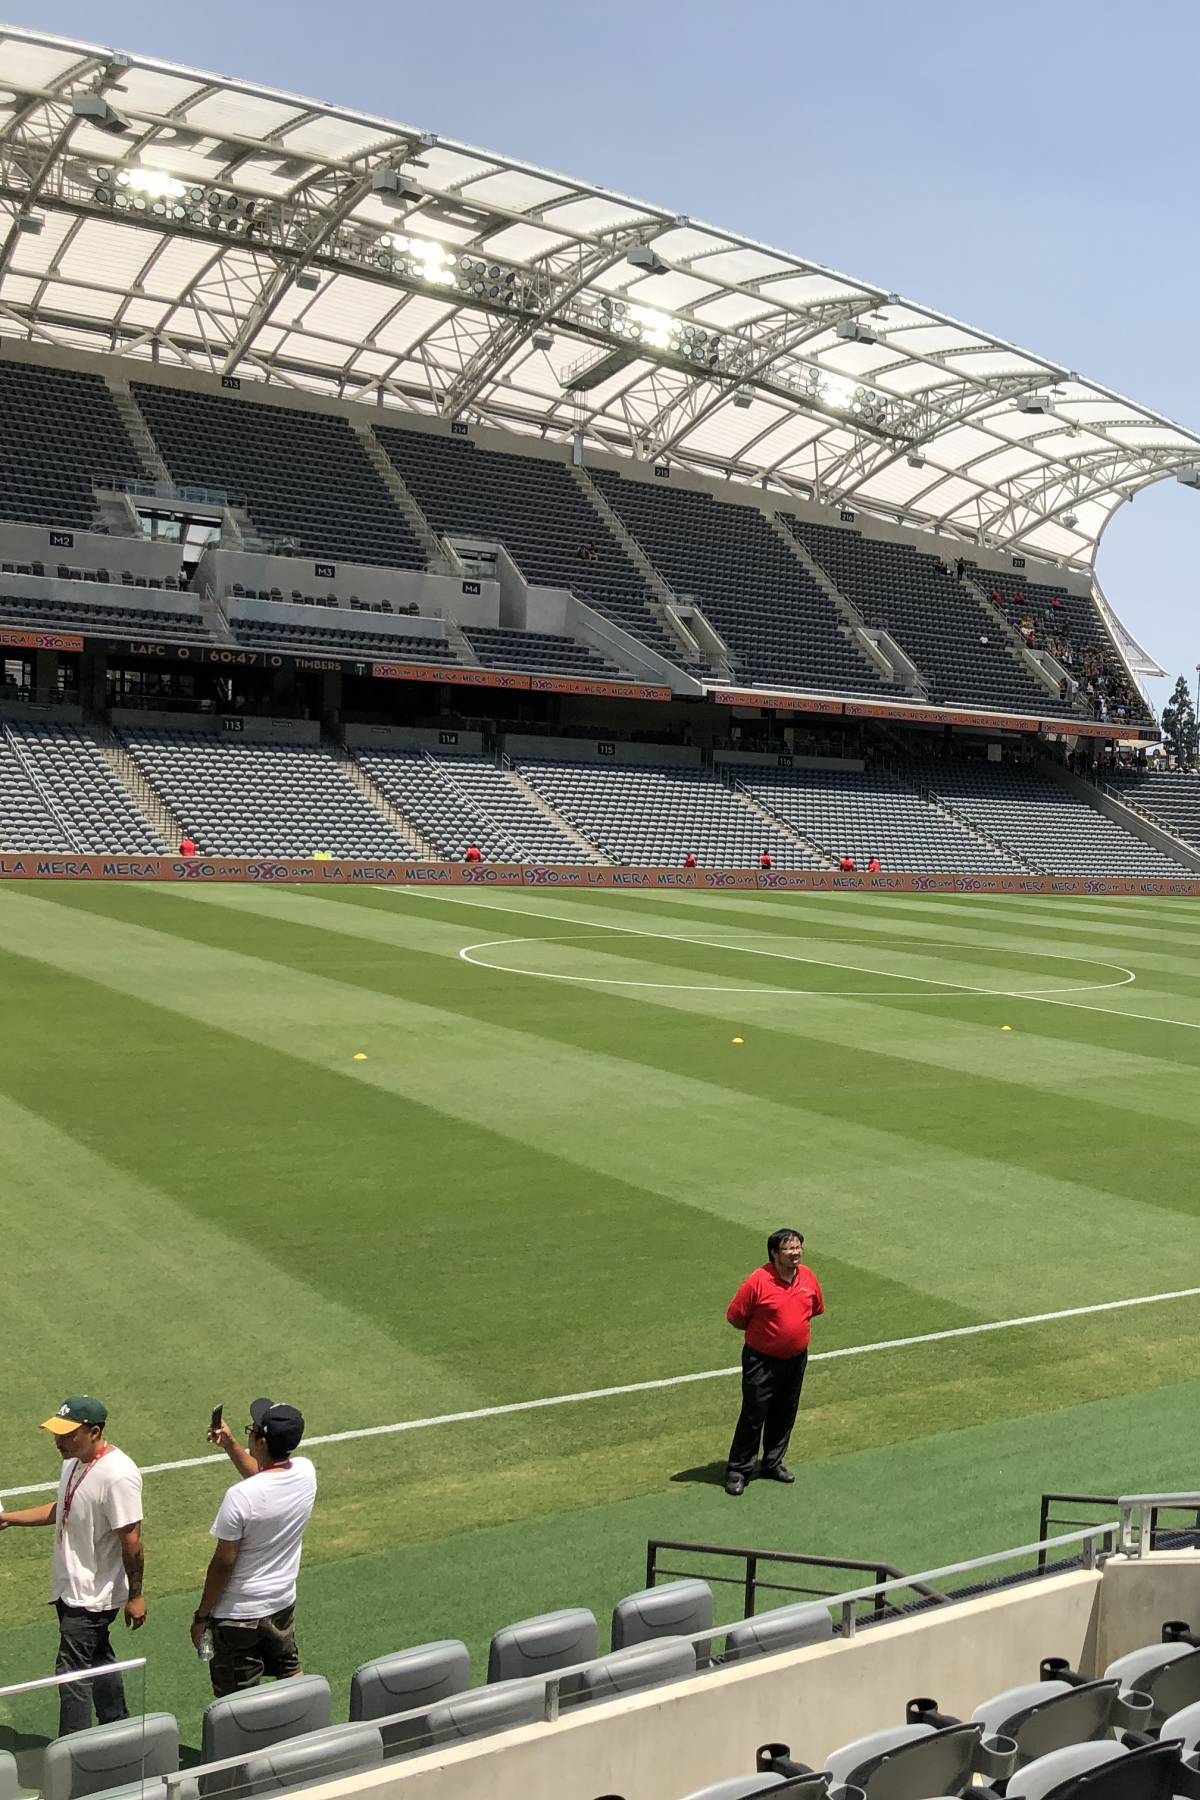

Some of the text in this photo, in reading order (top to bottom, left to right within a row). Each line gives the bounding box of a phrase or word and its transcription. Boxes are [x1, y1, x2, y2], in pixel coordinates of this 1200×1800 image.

[223, 378, 240, 388] 213
[53, 536, 70, 545] M2
[317, 566, 333, 575] M3
[465, 584, 479, 594] M4
[0, 634, 31, 644] ERA!
[130, 643, 166, 656] LAFC
[209, 651, 257, 665] 60:47
[294, 658, 341, 671] TIMBERS
[224, 720, 241, 730] 113
[1, 861, 26, 873] LA
[37, 861, 92, 875] MERA
[102, 862, 161, 876] MERA!
[322, 866, 344, 878] LA
[352, 867, 398, 880] MERA
[405, 868, 452, 881] MERA!
[587, 872, 604, 883] LA
[612, 872, 650, 884] MERA
[657, 873, 697, 885] MERA!
[811, 877, 826, 887] LA
[832, 877, 864, 888] MERA
